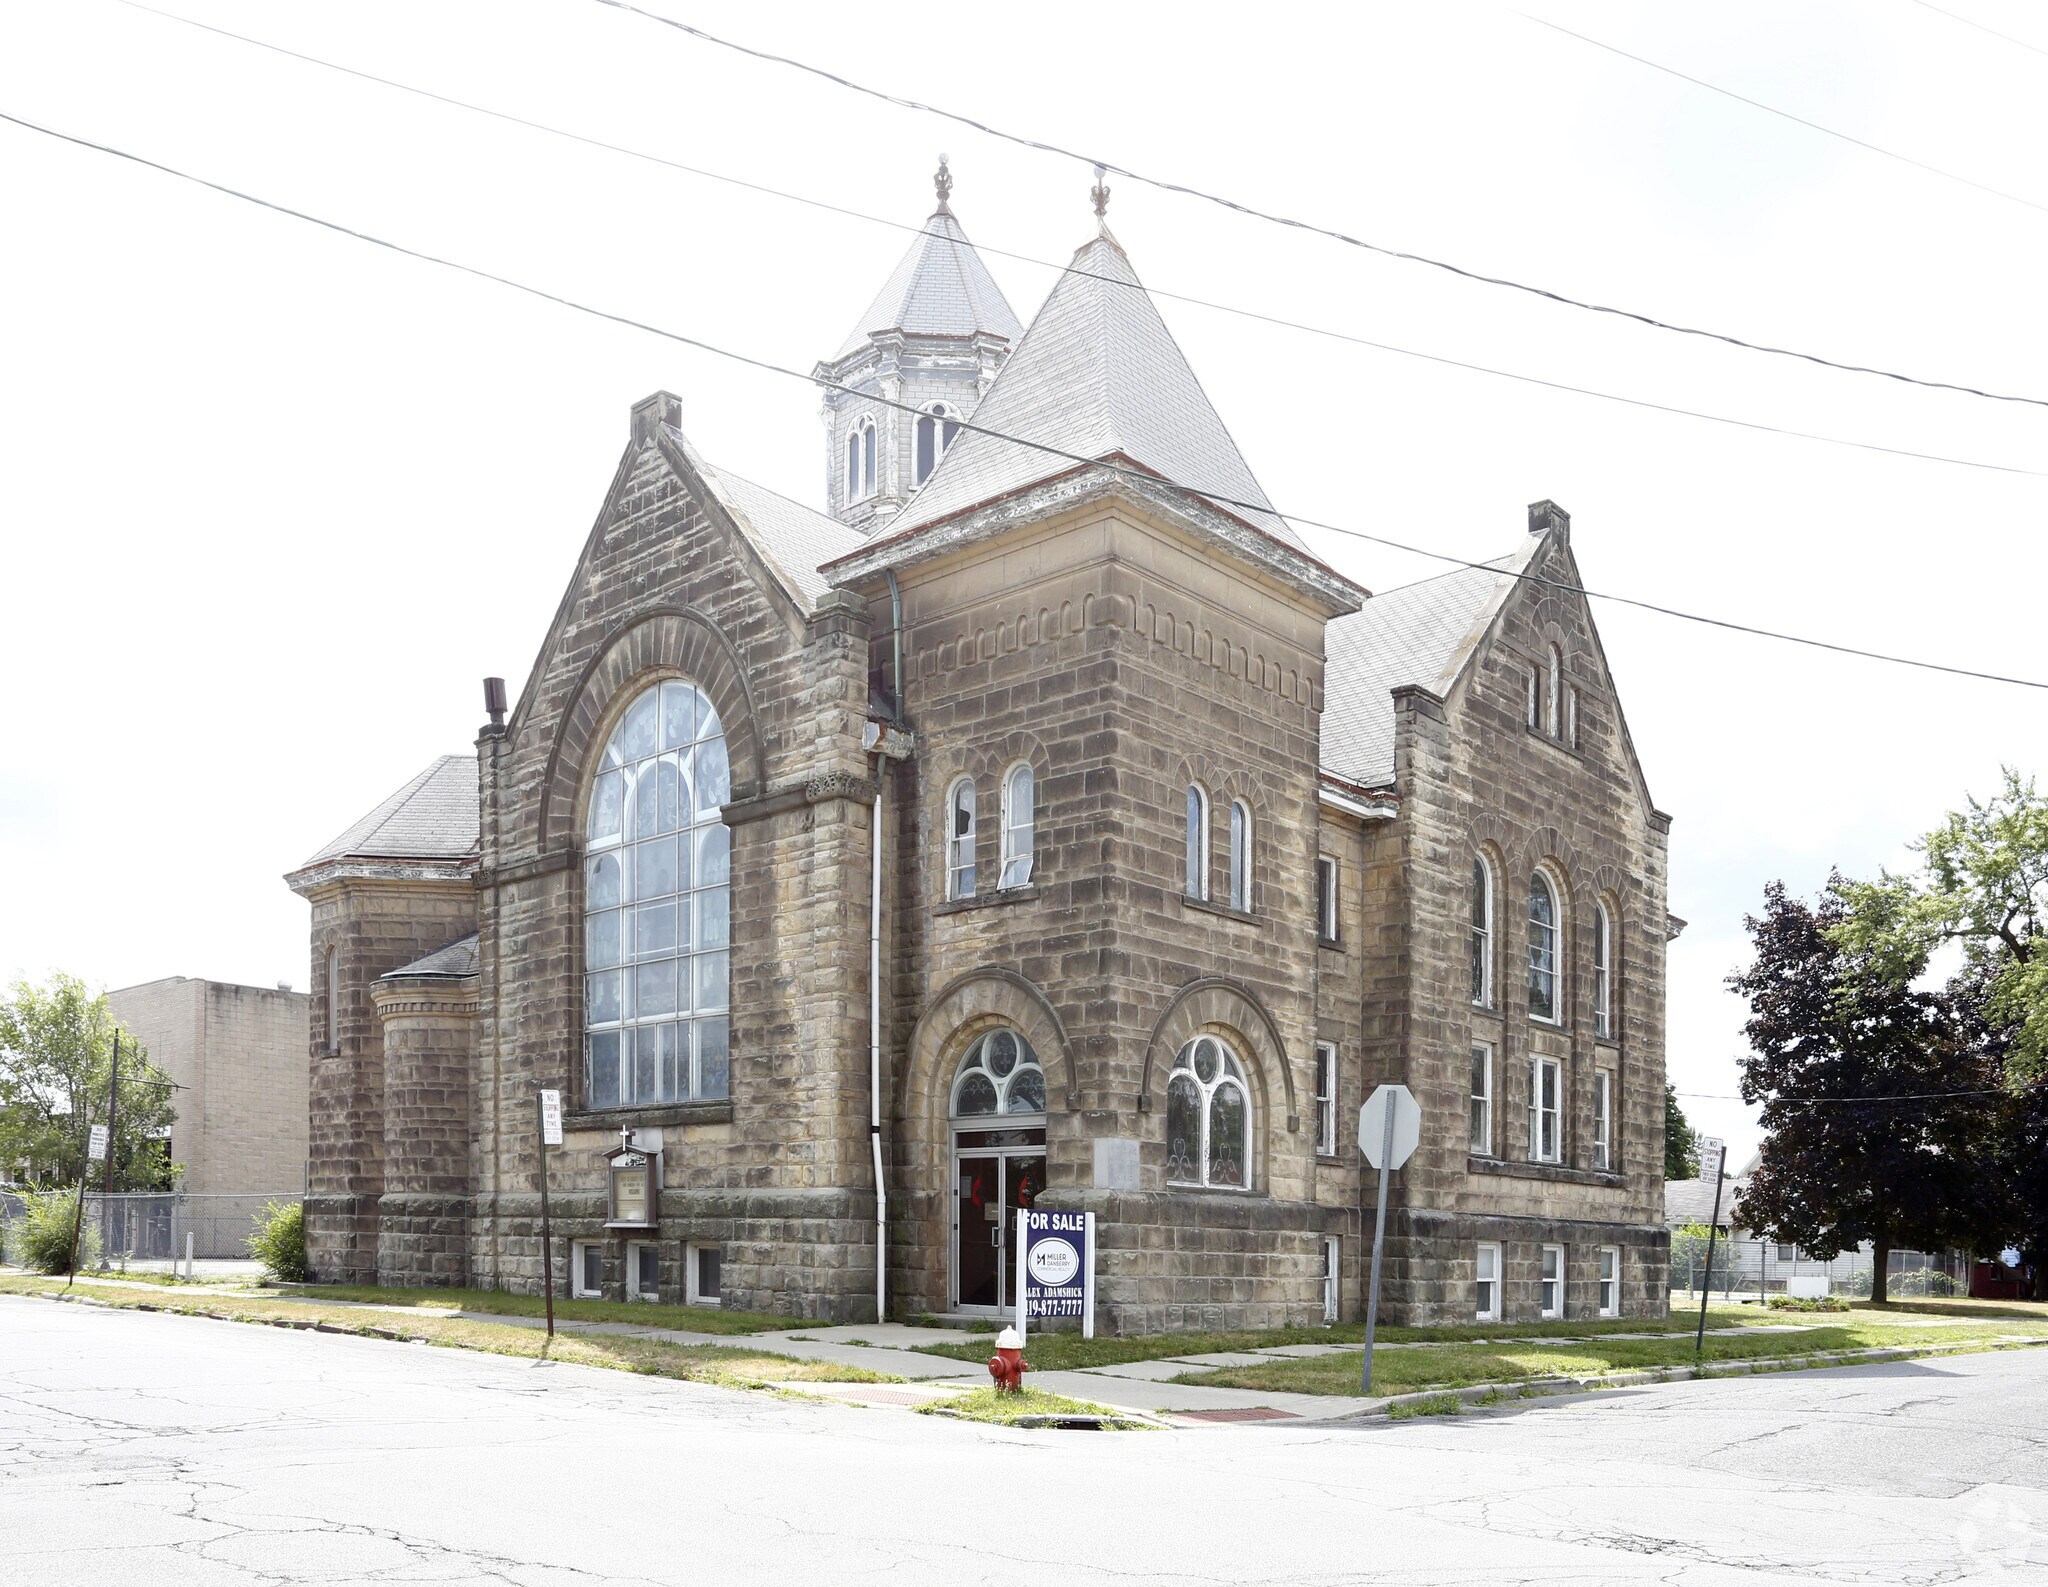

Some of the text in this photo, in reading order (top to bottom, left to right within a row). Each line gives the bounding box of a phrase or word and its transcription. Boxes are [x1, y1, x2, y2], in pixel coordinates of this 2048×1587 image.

[547, 1094, 555, 1102] NO
[1704, 1148, 1721, 1157] STOPPING
[1052, 1213, 1084, 1231] SALE
[1047, 1253, 1067, 1261] MILLER
[1027, 1287, 1083, 1298] LEX ADAMSHICK
[1026, 1299, 1083, 1316] 19-877-7777
